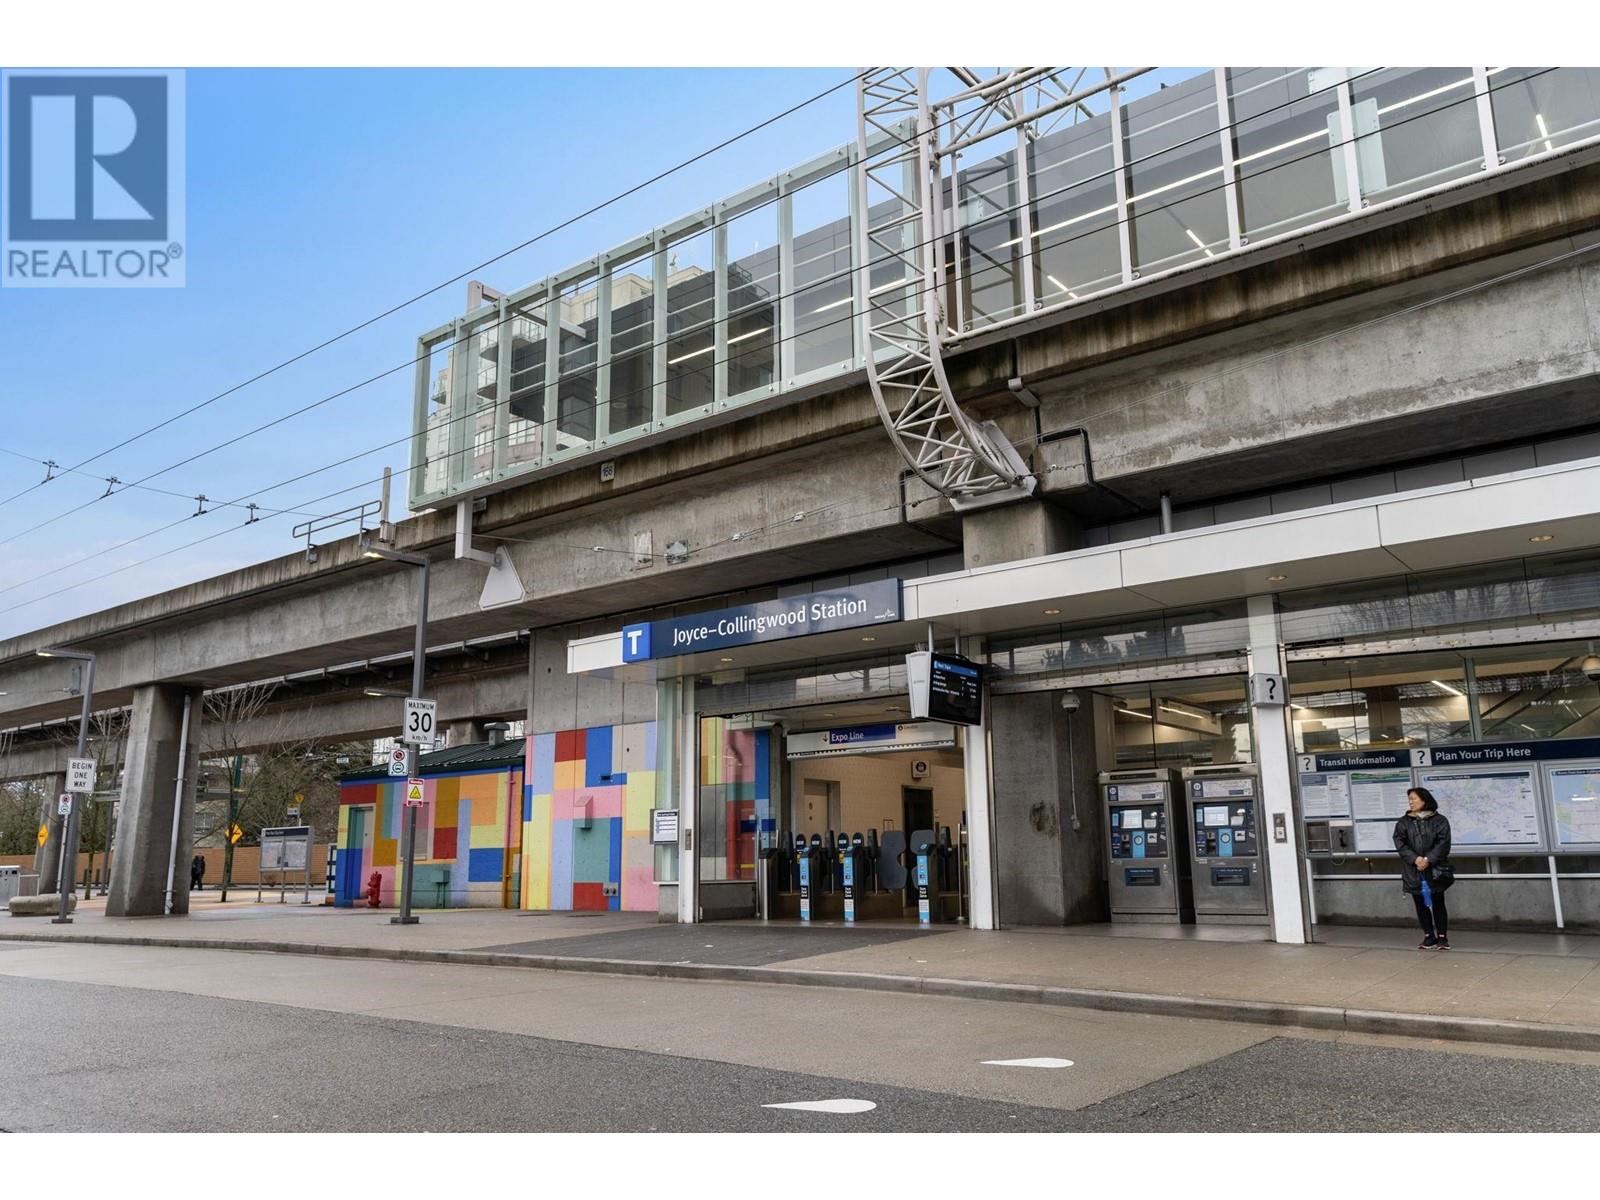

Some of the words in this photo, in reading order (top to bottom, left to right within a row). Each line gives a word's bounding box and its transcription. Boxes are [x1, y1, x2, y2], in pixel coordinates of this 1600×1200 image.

[811, 597, 867, 620] Station
[627, 630, 643, 655] T
[408, 702, 434, 710] MAXIMUM
[409, 711, 432, 733] 30
[831, 733, 849, 743] Expo
[849, 731, 865, 741] Line
[1435, 751, 1458, 761] Plan
[1460, 749, 1482, 760] Your
[1485, 748, 1504, 760] Trip
[1506, 747, 1531, 757] Here
[72, 762, 93, 770] BEGIN
[1320, 758, 1347, 767] Transit
[1348, 755, 1396, 765] Information
[74, 771, 89, 779] ONE
